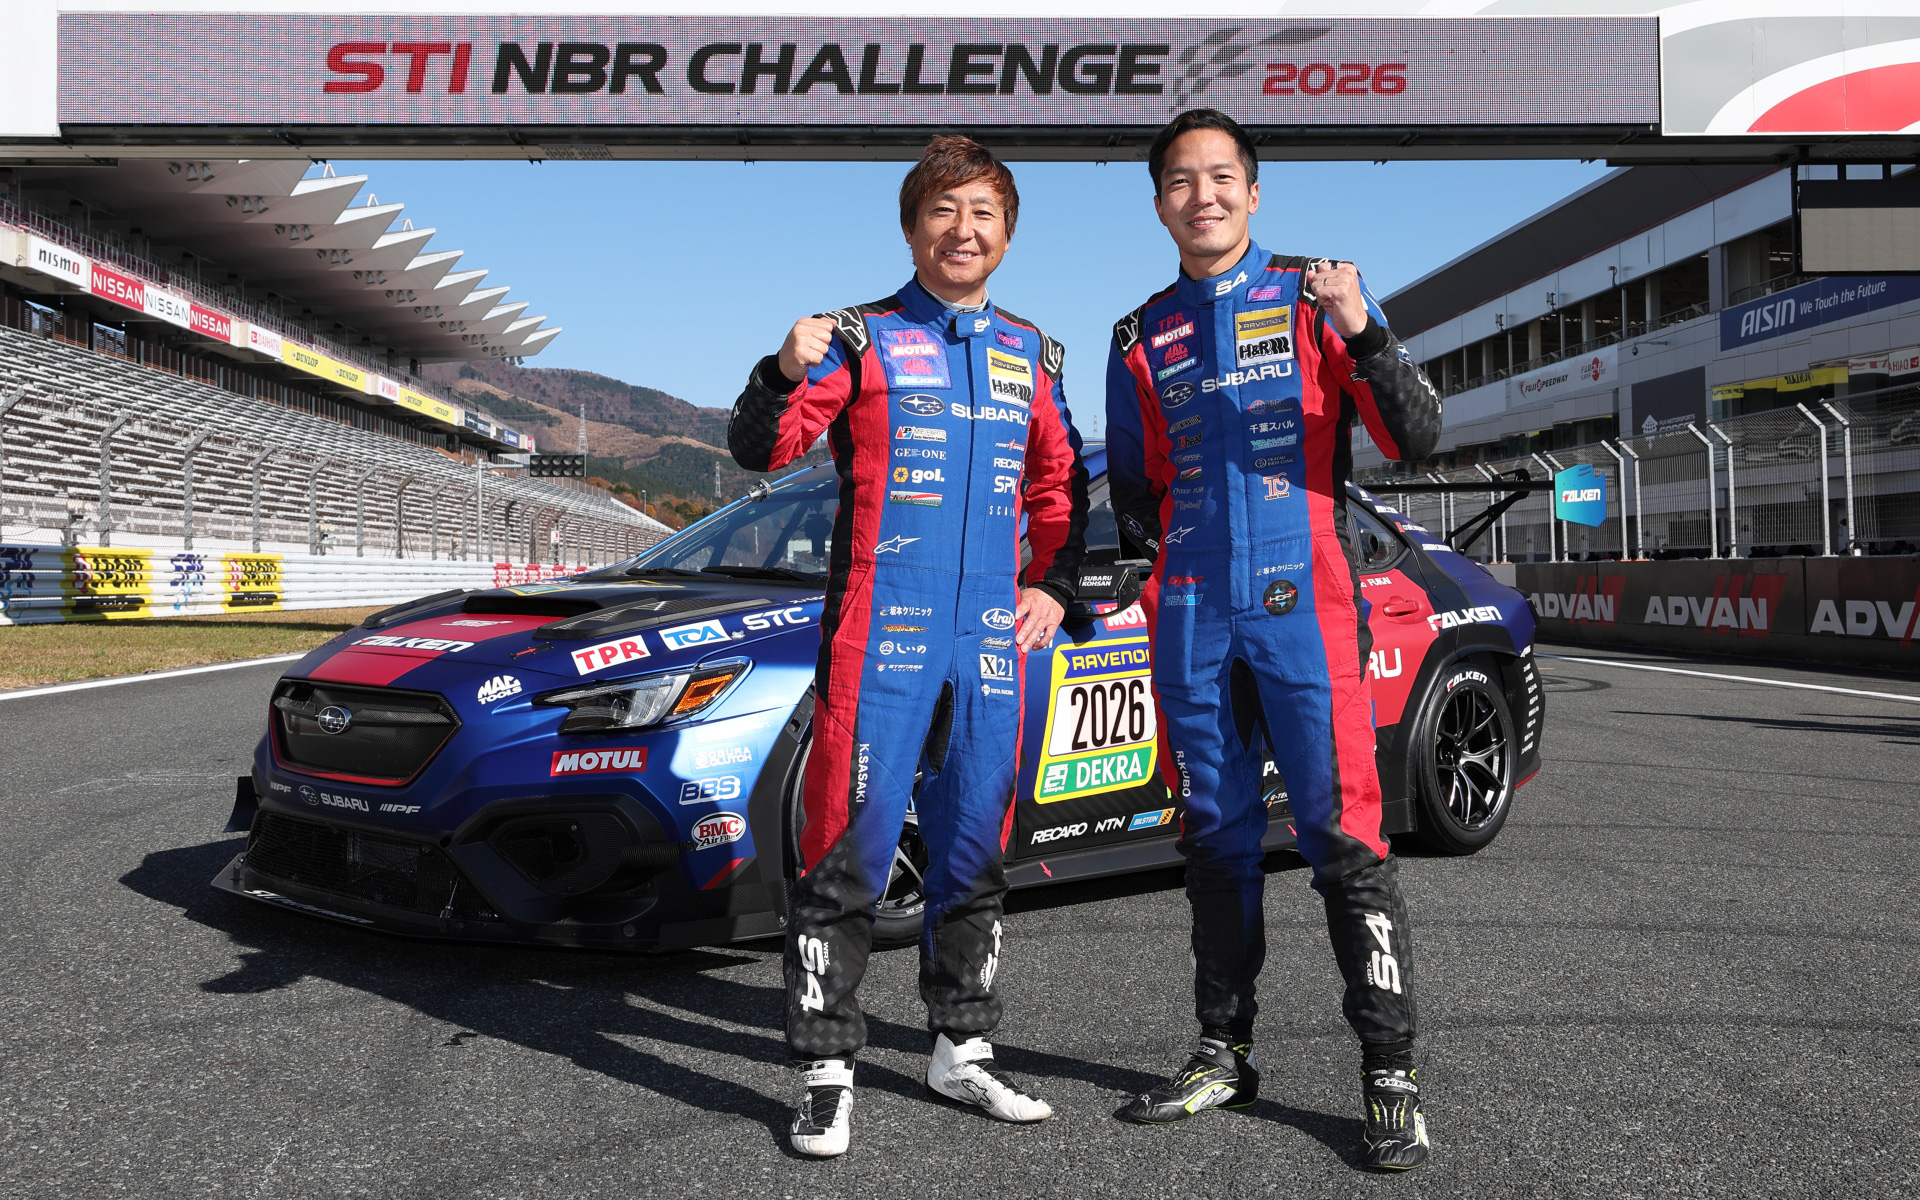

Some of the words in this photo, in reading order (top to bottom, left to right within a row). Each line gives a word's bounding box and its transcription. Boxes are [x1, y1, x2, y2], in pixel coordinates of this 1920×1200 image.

[323, 41, 472, 94] STI
[491, 42, 668, 95] NBR
[686, 42, 1170, 95] CHALLENGE
[1262, 63, 1407, 96] 2026
[38, 248, 80, 276] nismo
[92, 270, 143, 306] NISSAN
[1215, 270, 1249, 297] S4
[145, 293, 189, 323] NISSAN
[1741, 298, 1795, 337] AISIN
[1800, 301, 1813, 316] We
[1815, 294, 1839, 310] Touch
[1841, 290, 1855, 303] the
[1857, 280, 1887, 299] Future
[190, 309, 230, 338] NISSAN
[1158, 312, 1185, 332] TPR
[1243, 317, 1283, 330] RAVENOL
[258, 333, 281, 353] DAIHATSU
[894, 331, 928, 344] TPR
[1154, 324, 1192, 347] MOTUL
[295, 351, 319, 368] DUNLOP
[893, 345, 936, 356] MOTUL
[1165, 342, 1188, 361] MAC
[1165, 353, 1188, 366] TOOLS
[339, 368, 359, 383] DUNLOP
[993, 359, 1025, 372] RAVENOL
[1162, 358, 1195, 378] FALKEN
[1201, 362, 1292, 394] SUBARU
[951, 402, 1029, 426] SUBARU
[1249, 420, 1295, 435] 千葉スバル
[911, 468, 945, 484] gol.
[1561, 488, 1601, 503] FALKEN
[1269, 593, 1292, 603] HDP
[1529, 592, 1614, 622] ADVAN
[742, 606, 810, 631] STC
[986, 609, 1012, 625] Arai
[1427, 605, 1503, 632] FALKEN
[1643, 595, 1768, 631] ADVAN
[1810, 599, 1920, 639] ADV
[350, 635, 475, 653] FALKEN
[575, 640, 646, 671] TPR
[477, 675, 522, 699] MAC
[1446, 671, 1488, 693] FALKEN
[478, 685, 523, 705] TOOLS
[1071, 679, 1145, 751] 2026
[555, 750, 643, 773] MOTUL
[1076, 751, 1143, 789] DEKRA
[855, 743, 870, 804] K.SASAKI
[1176, 750, 1192, 798] R.KUBO
[320, 792, 370, 812] SUBARU
[679, 775, 741, 806] BBS
[698, 819, 739, 838] BMC
[1095, 815, 1126, 834] NTN
[1133, 815, 1159, 827] BILSTEIN
[700, 835, 720, 847] Air
[1031, 821, 1089, 845] RECARO
[823, 941, 831, 966] WRX
[1364, 911, 1402, 995] S4
[798, 934, 825, 1012] S4
[1365, 960, 1374, 986] WRX
